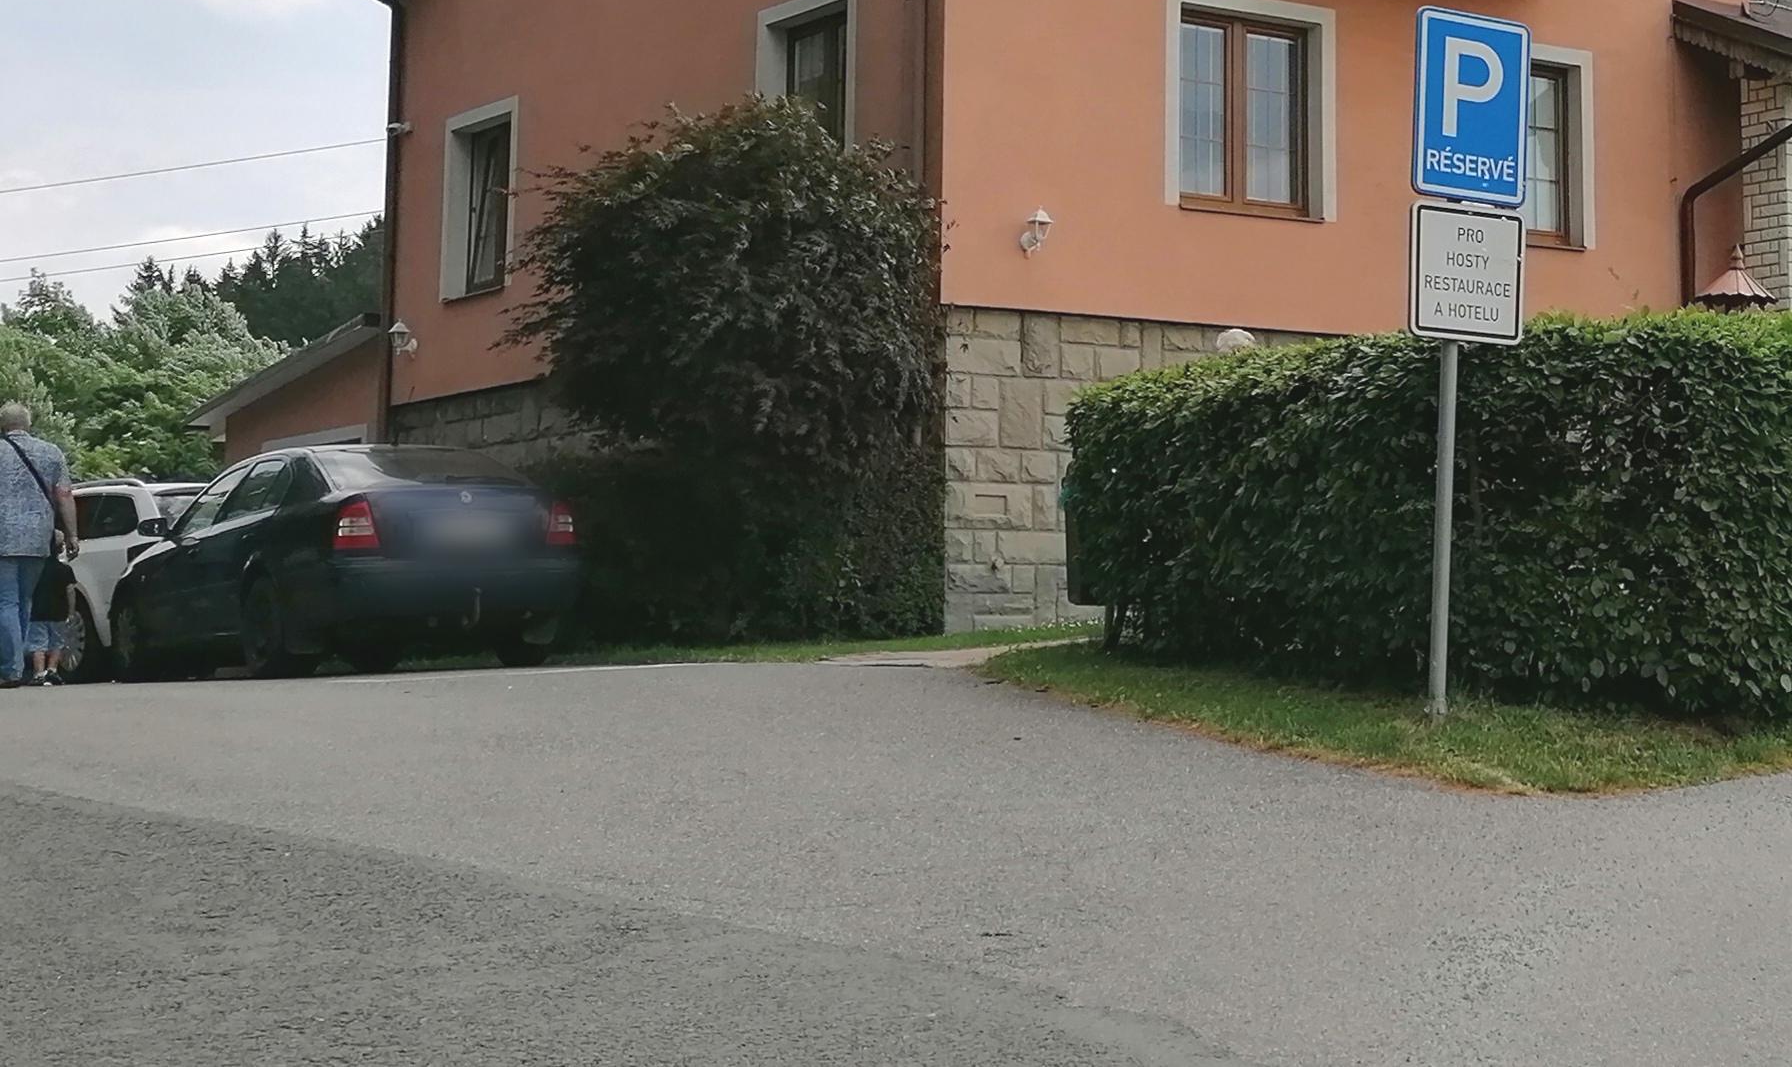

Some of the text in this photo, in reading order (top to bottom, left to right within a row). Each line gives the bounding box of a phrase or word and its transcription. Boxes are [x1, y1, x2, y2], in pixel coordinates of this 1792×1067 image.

[1442, 36, 1504, 138] P
[1426, 146, 1516, 183] RÉSERVÉ
[1457, 227, 1484, 244] PRO
[1446, 251, 1490, 270] HOSTY
[1424, 274, 1511, 299] RESTAURACE
[1434, 301, 1500, 323] A HOTELU
